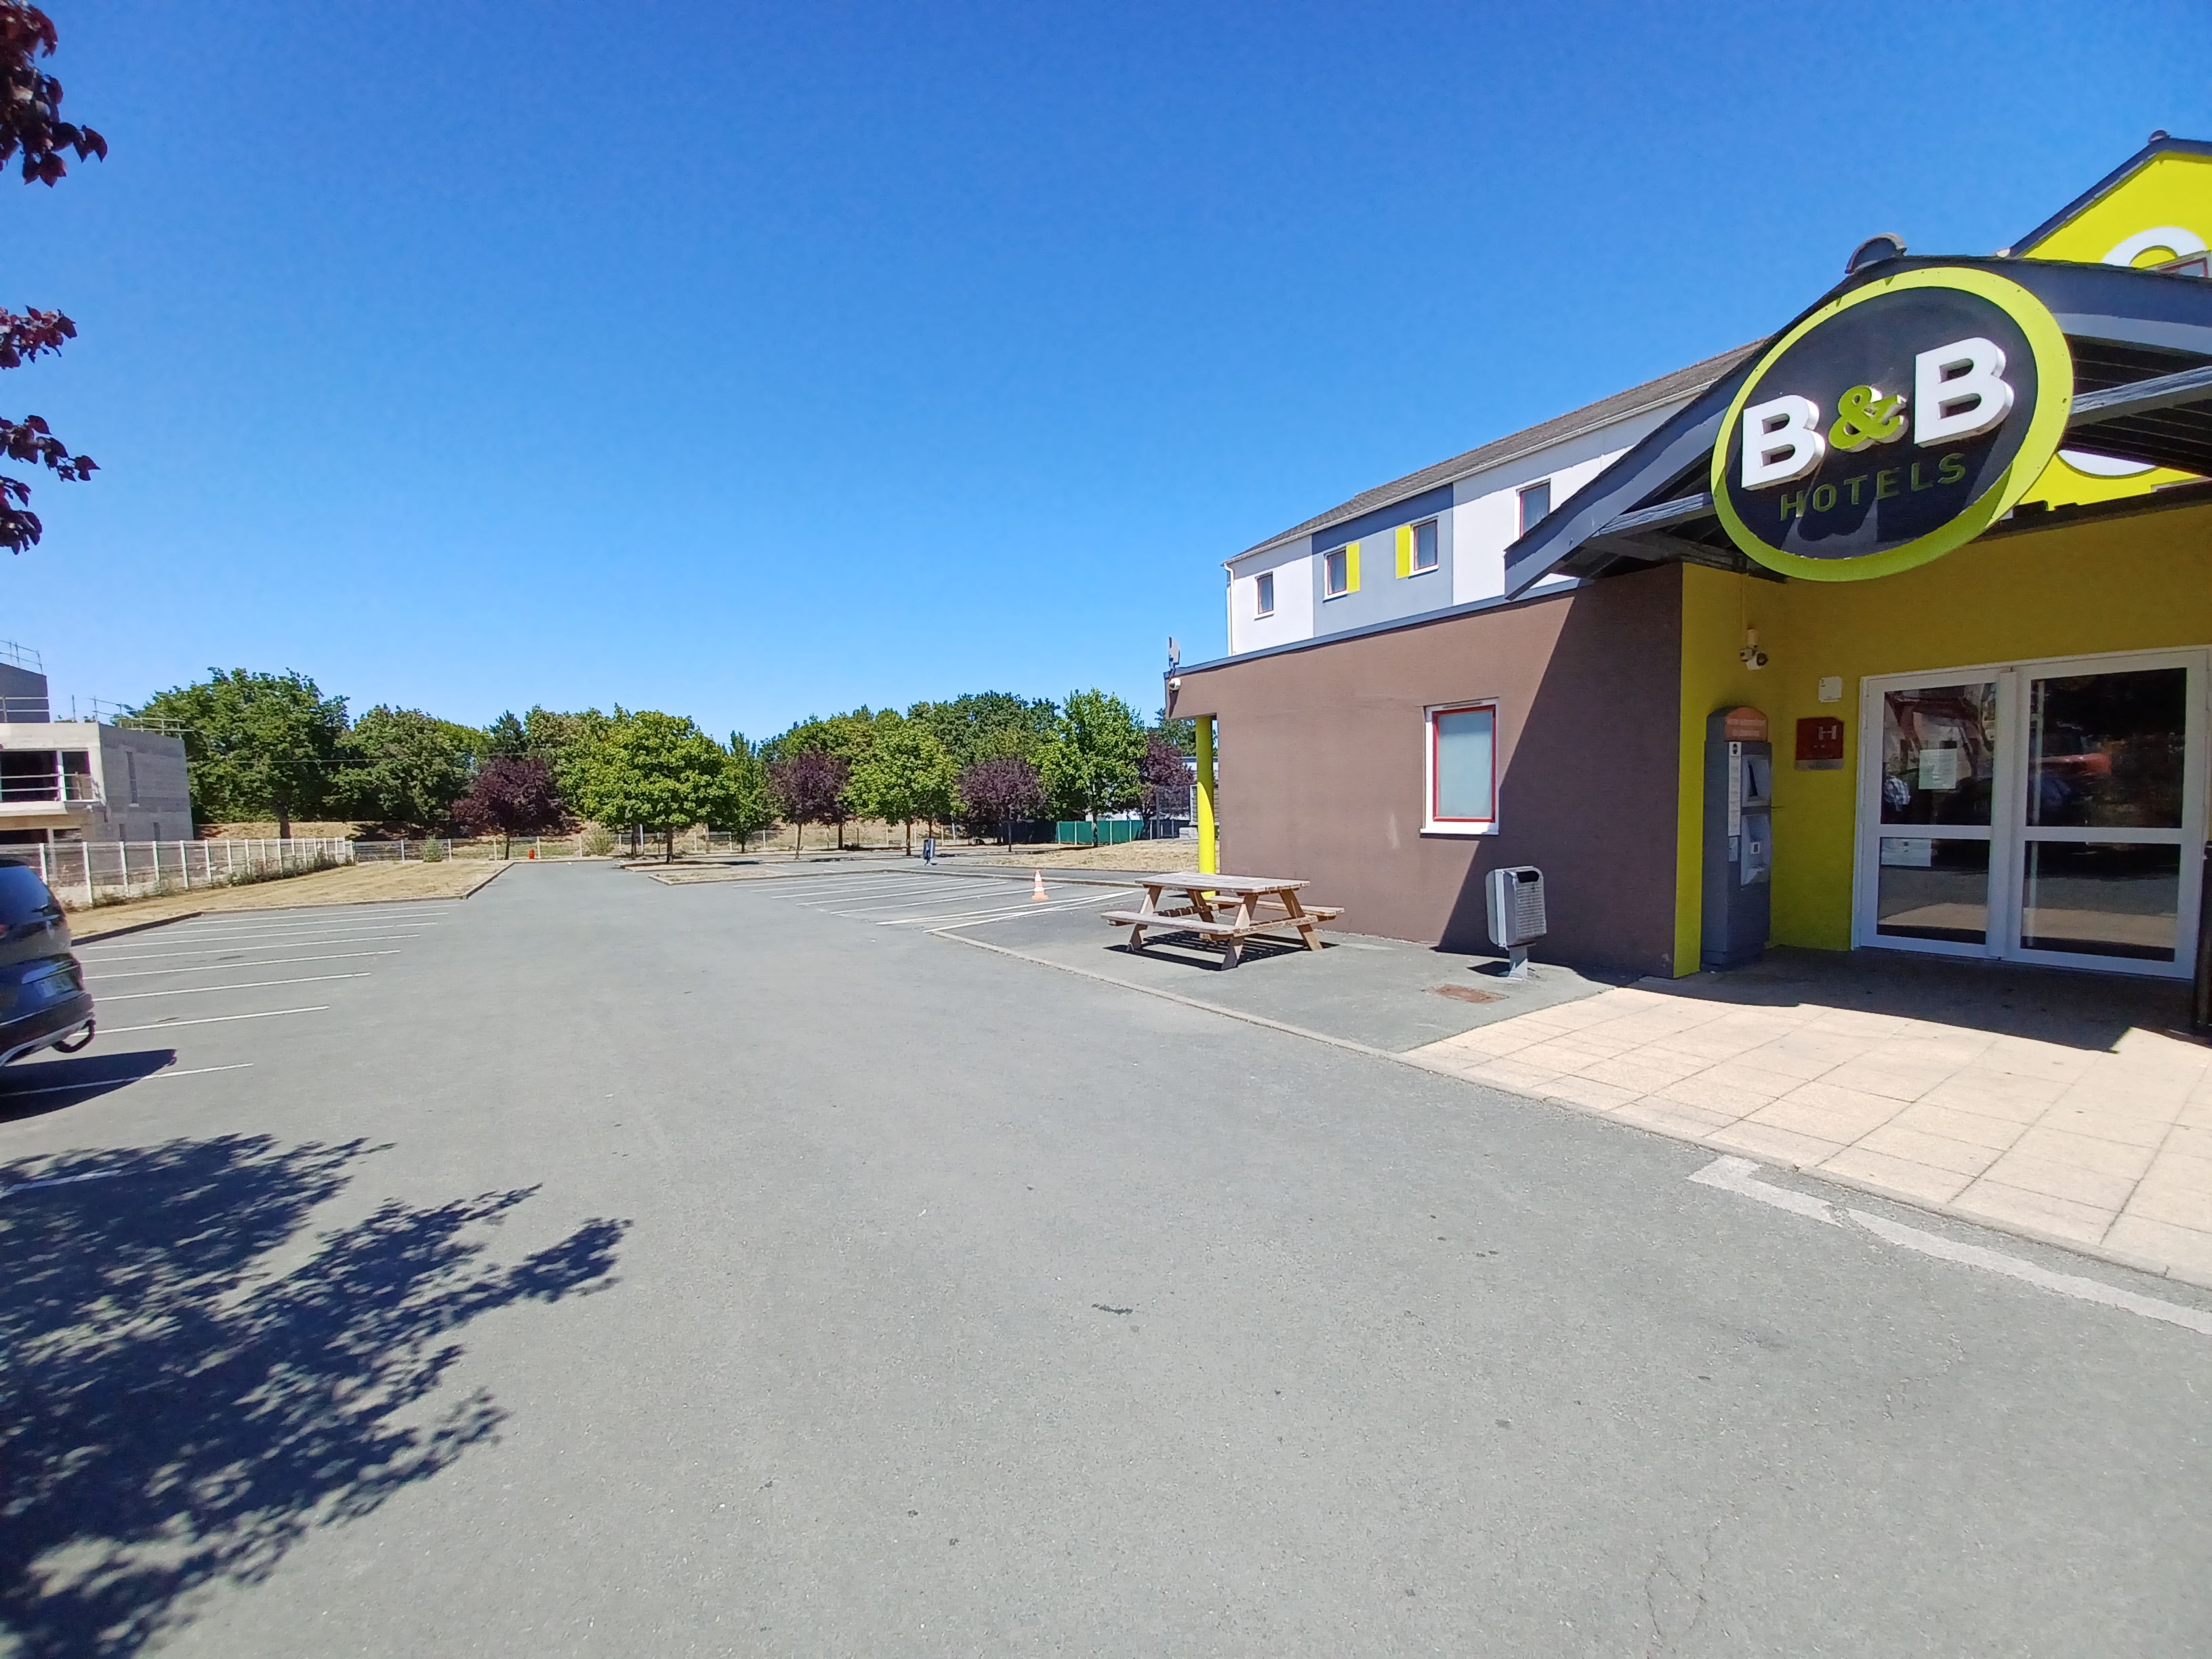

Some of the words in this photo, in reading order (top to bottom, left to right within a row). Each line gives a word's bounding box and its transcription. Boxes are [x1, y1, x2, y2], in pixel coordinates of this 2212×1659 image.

[1741, 337, 2015, 491] B&B
[1779, 452, 1967, 522] HOTELS
[1818, 725, 1837, 741] H
